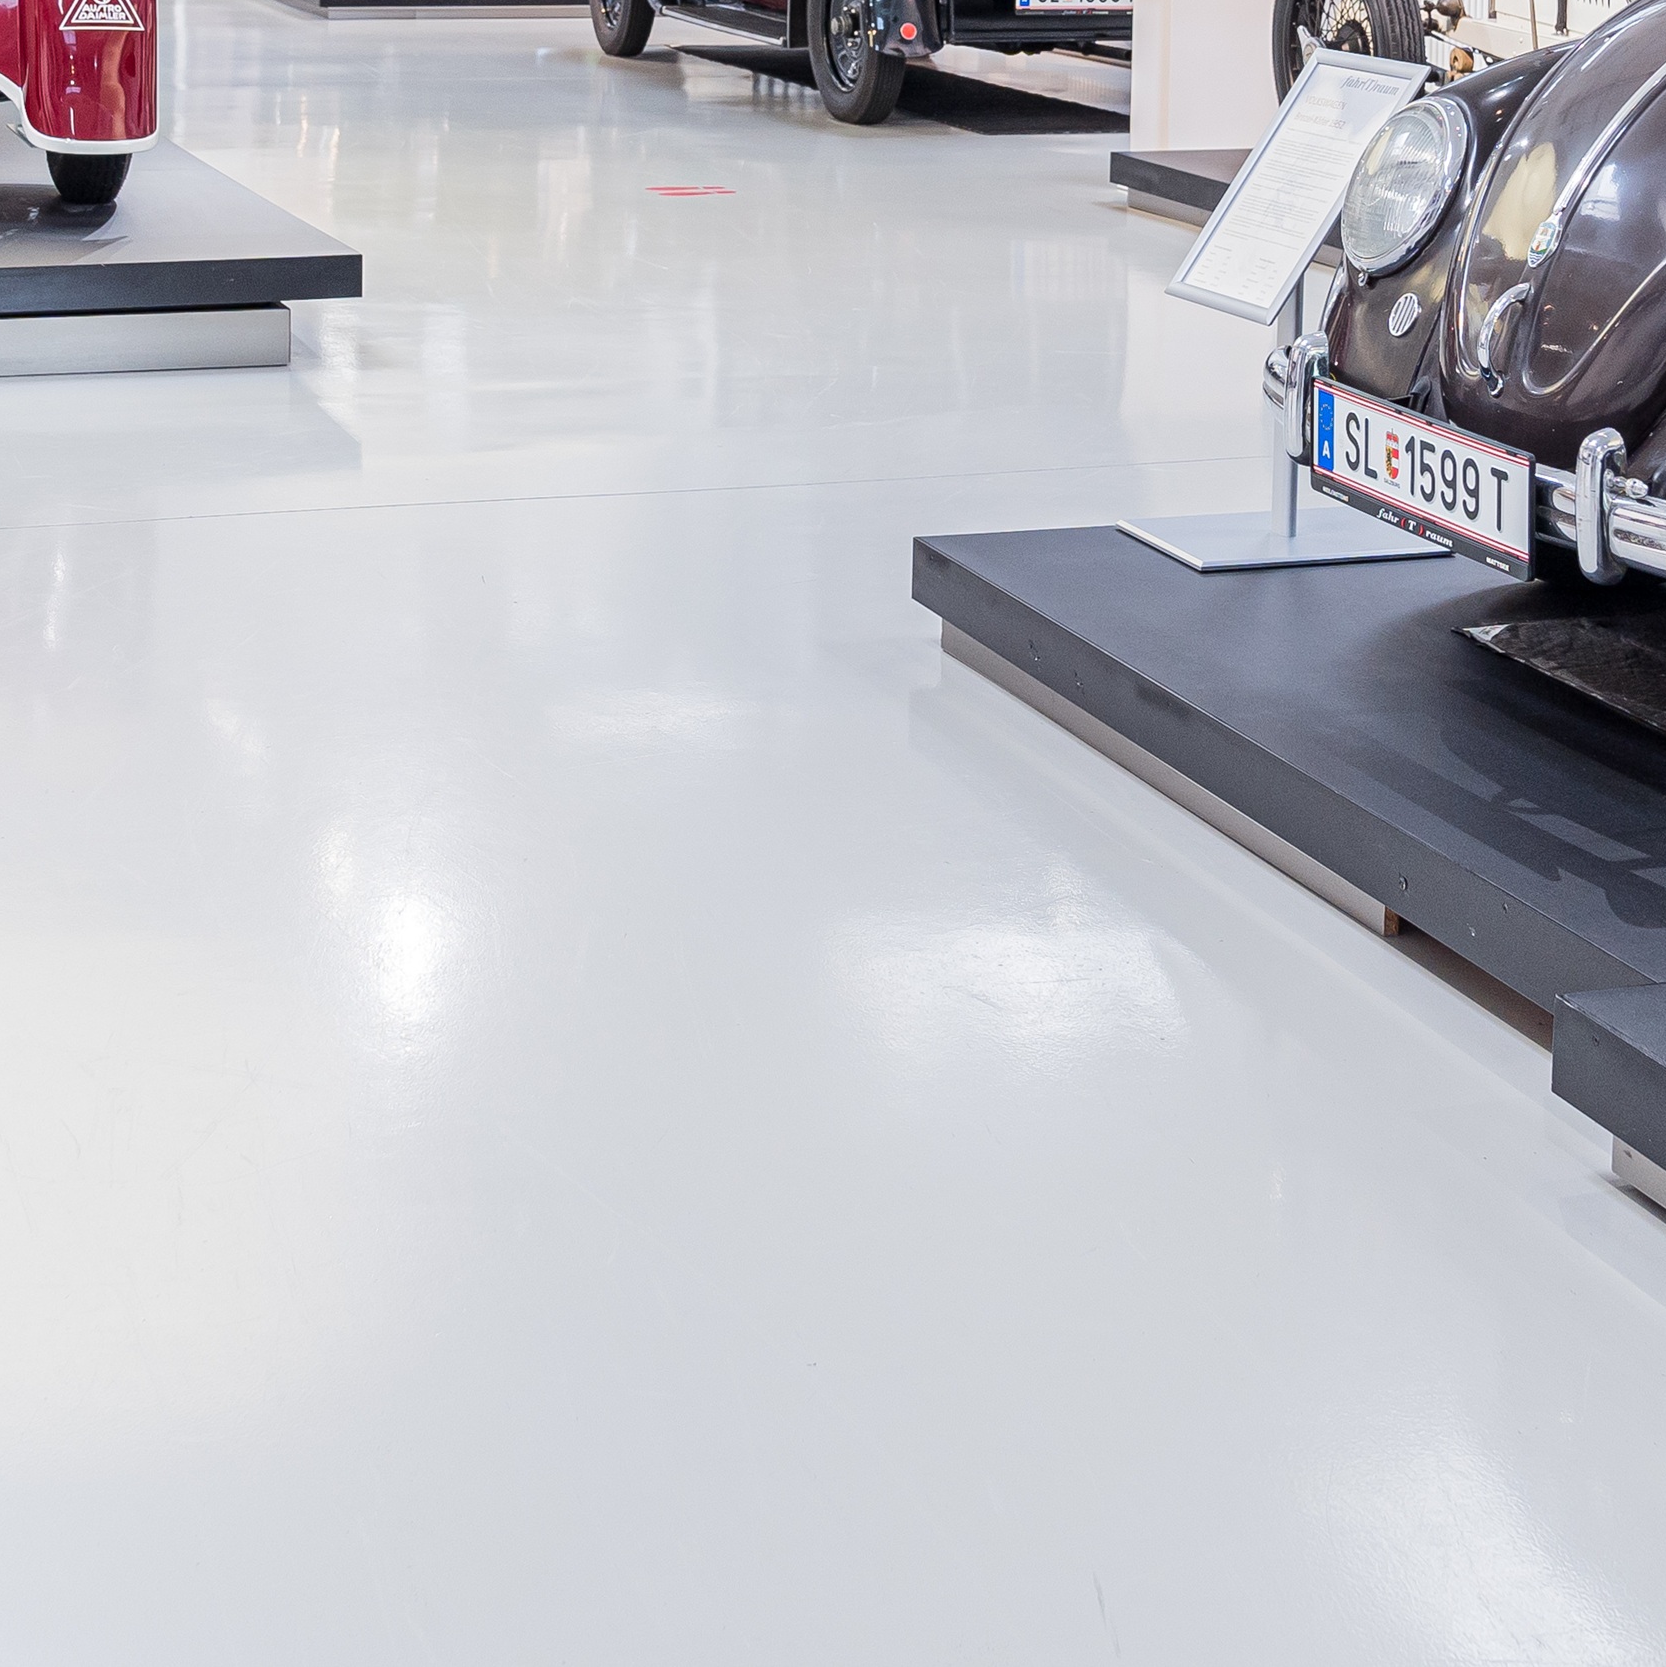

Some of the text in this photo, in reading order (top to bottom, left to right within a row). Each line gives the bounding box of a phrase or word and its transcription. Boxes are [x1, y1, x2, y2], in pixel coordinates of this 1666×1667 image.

[83, 4, 122, 13] AUSTRO
[78, 12, 126, 20] DAIMLER
[1305, 95, 1348, 111] VOLKSWAGEN
[1322, 412, 1509, 532] A SL 1599 T
